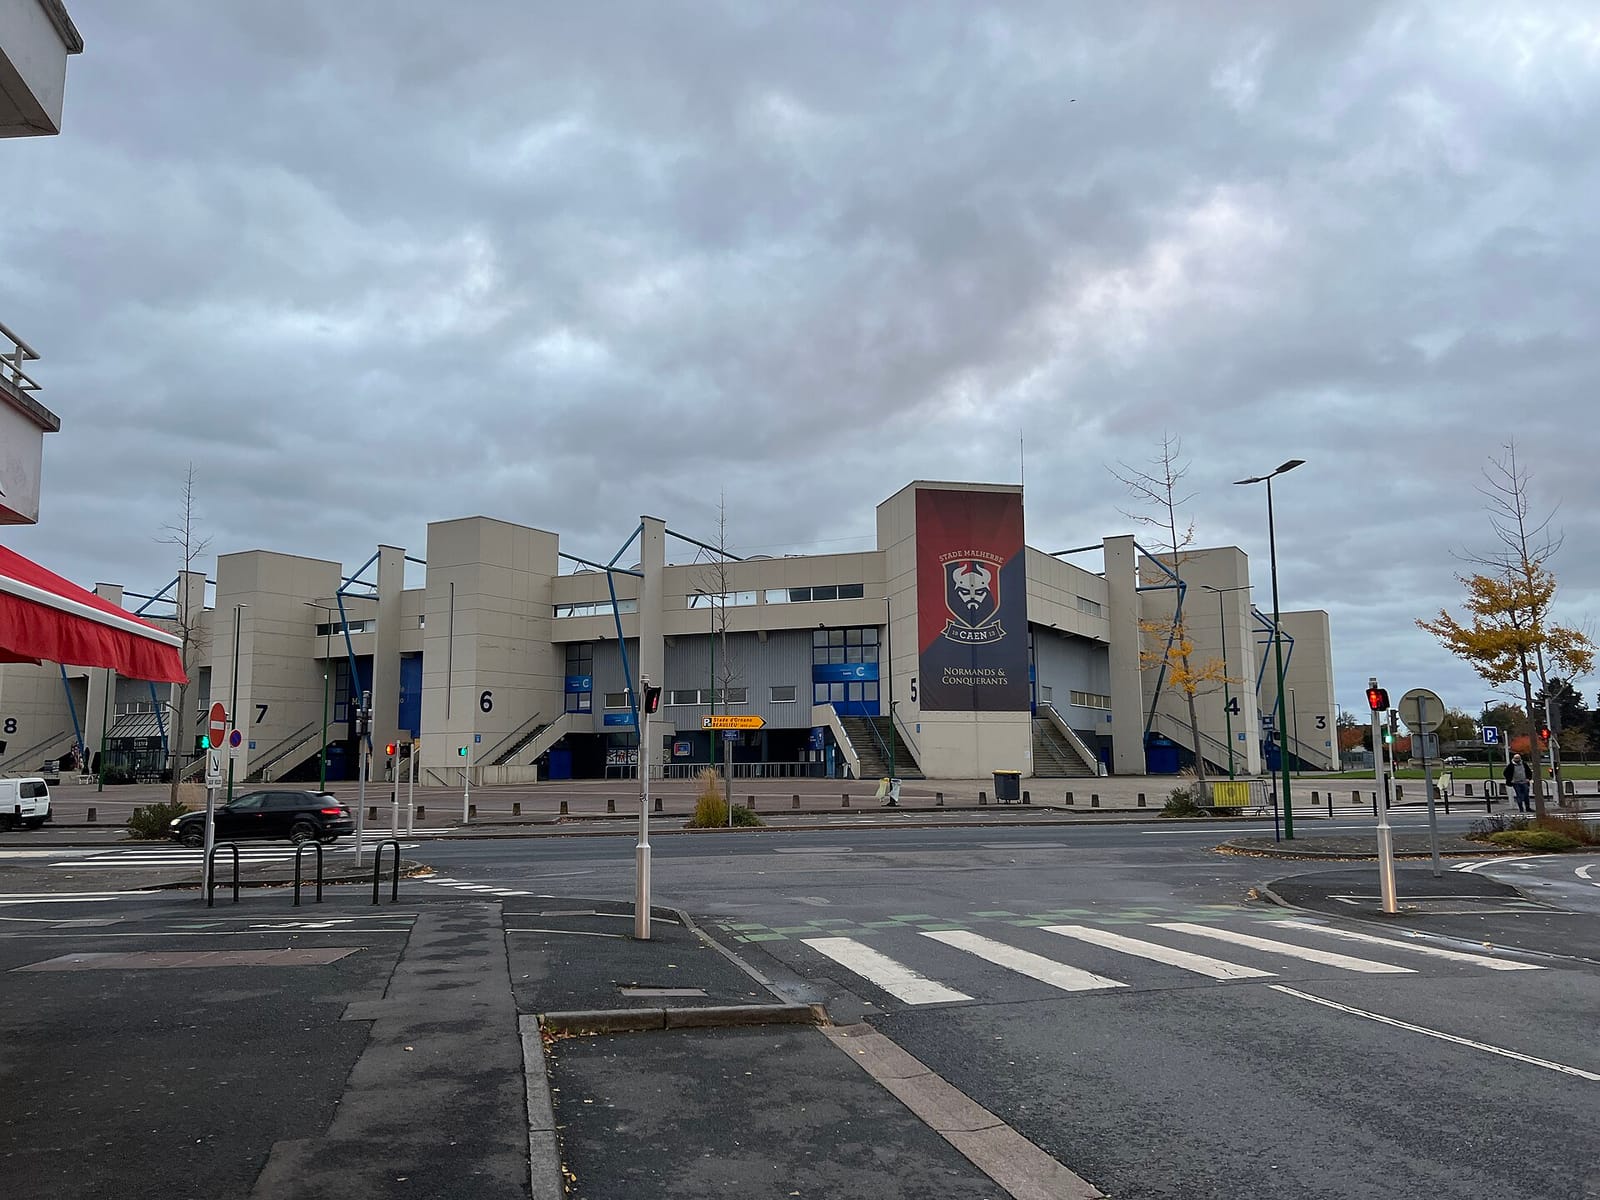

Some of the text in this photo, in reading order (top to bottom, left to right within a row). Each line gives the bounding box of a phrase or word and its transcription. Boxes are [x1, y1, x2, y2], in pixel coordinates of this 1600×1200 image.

[939, 550, 1004, 563] STADE MALHERBE
[959, 630, 988, 640] CAEN
[856, 666, 865, 677] C
[943, 667, 1006, 677] NORMANDS &
[582, 678, 590, 688] C
[942, 675, 1008, 687] CONQUERANTS
[910, 677, 917, 703] 5
[480, 690, 493, 713] 6
[1223, 697, 1241, 716] 4
[255, 704, 269, 724] 7
[4, 718, 17, 734] 8
[1315, 715, 1326, 730] 3
[1486, 730, 1494, 741] P
